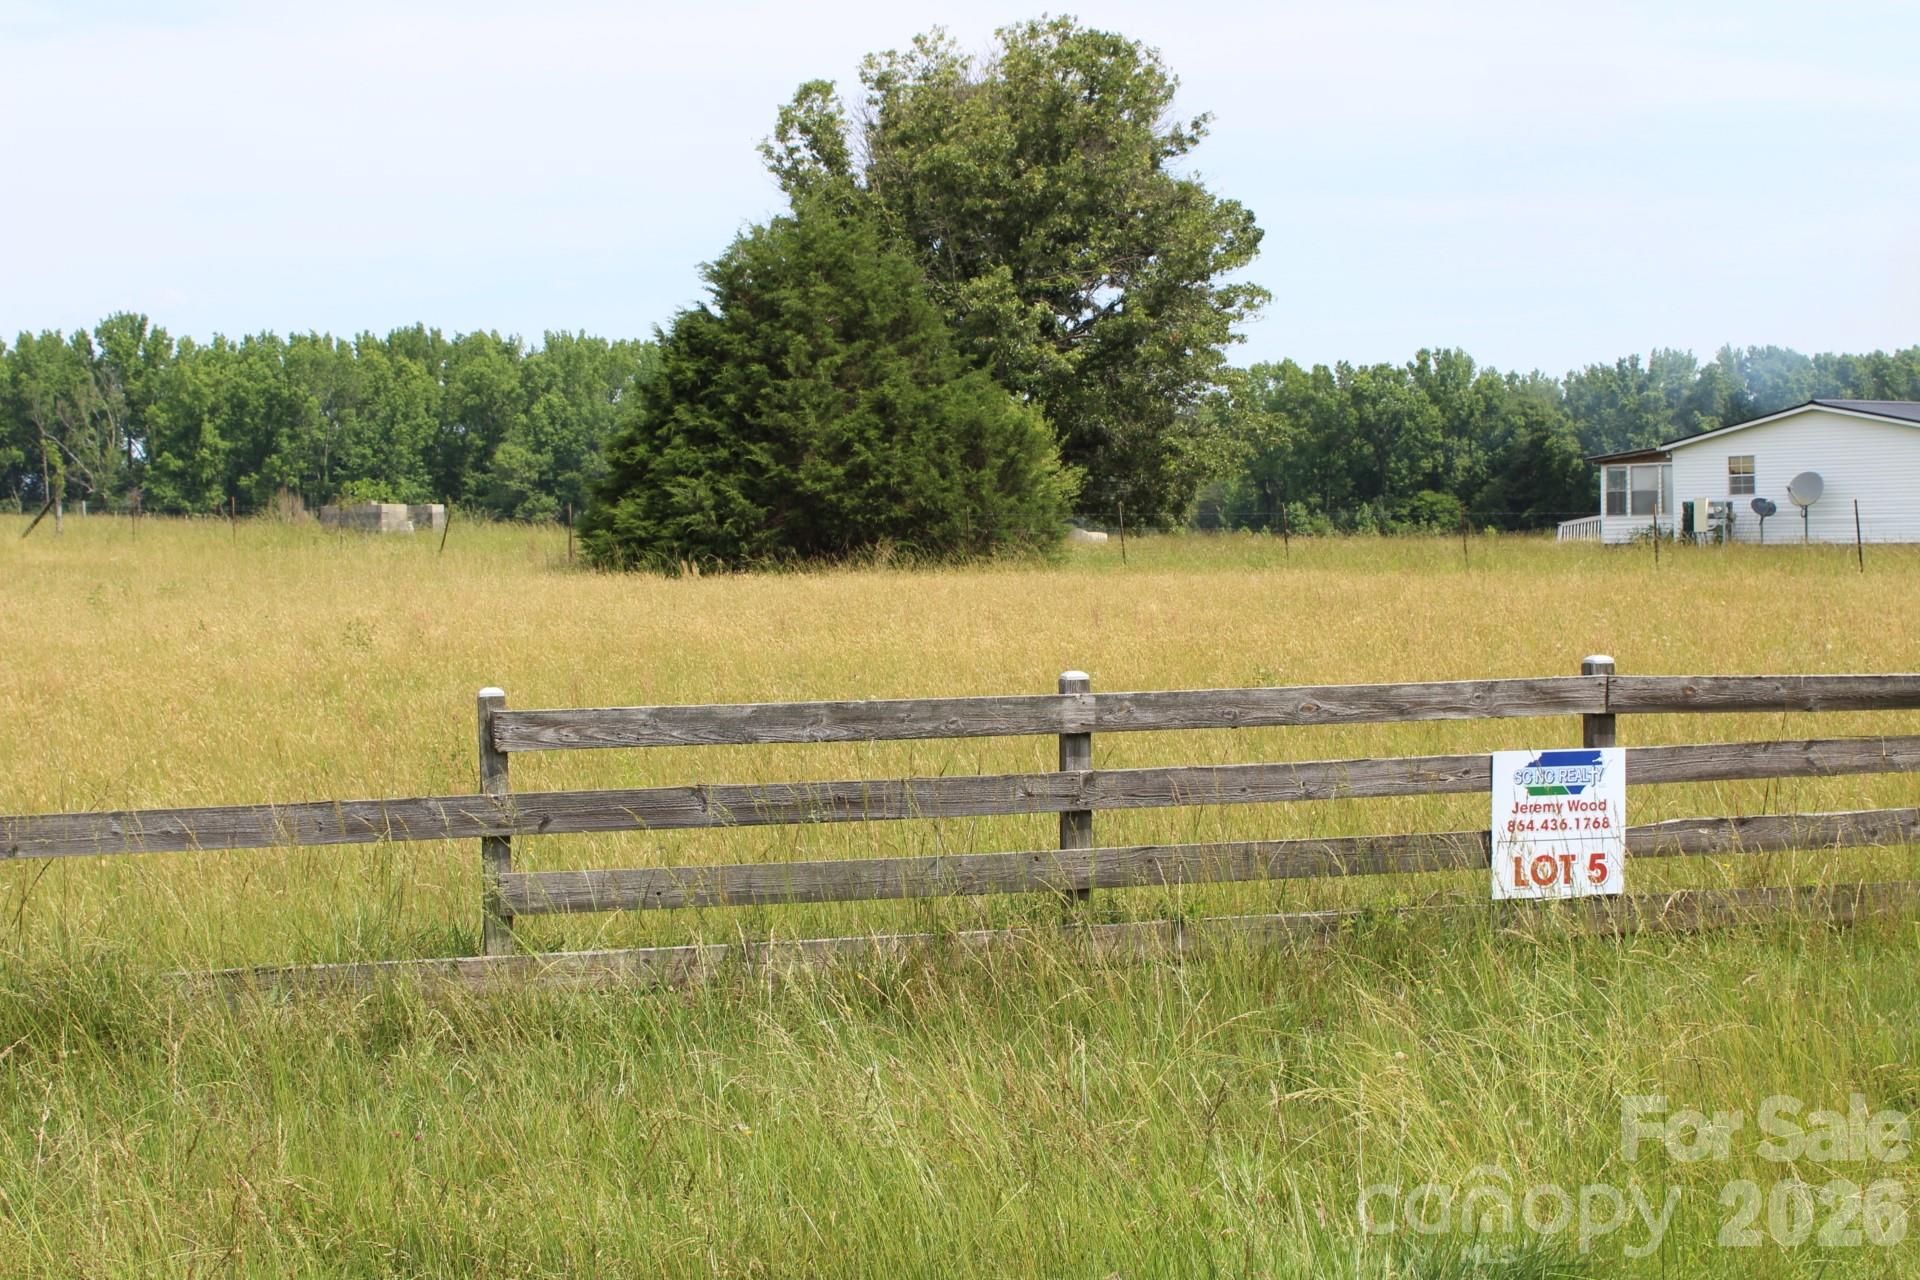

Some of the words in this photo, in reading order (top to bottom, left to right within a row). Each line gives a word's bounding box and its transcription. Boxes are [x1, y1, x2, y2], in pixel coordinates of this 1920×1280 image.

[1514, 770, 1533, 785] SC
[1534, 769, 1555, 785] NC
[1511, 801, 1563, 815] Jeremy
[1567, 799, 1607, 812] Wood
[1507, 817, 1610, 833] 864.436.1768
[1512, 854, 1577, 888] LOT
[1588, 853, 1609, 886] 5
